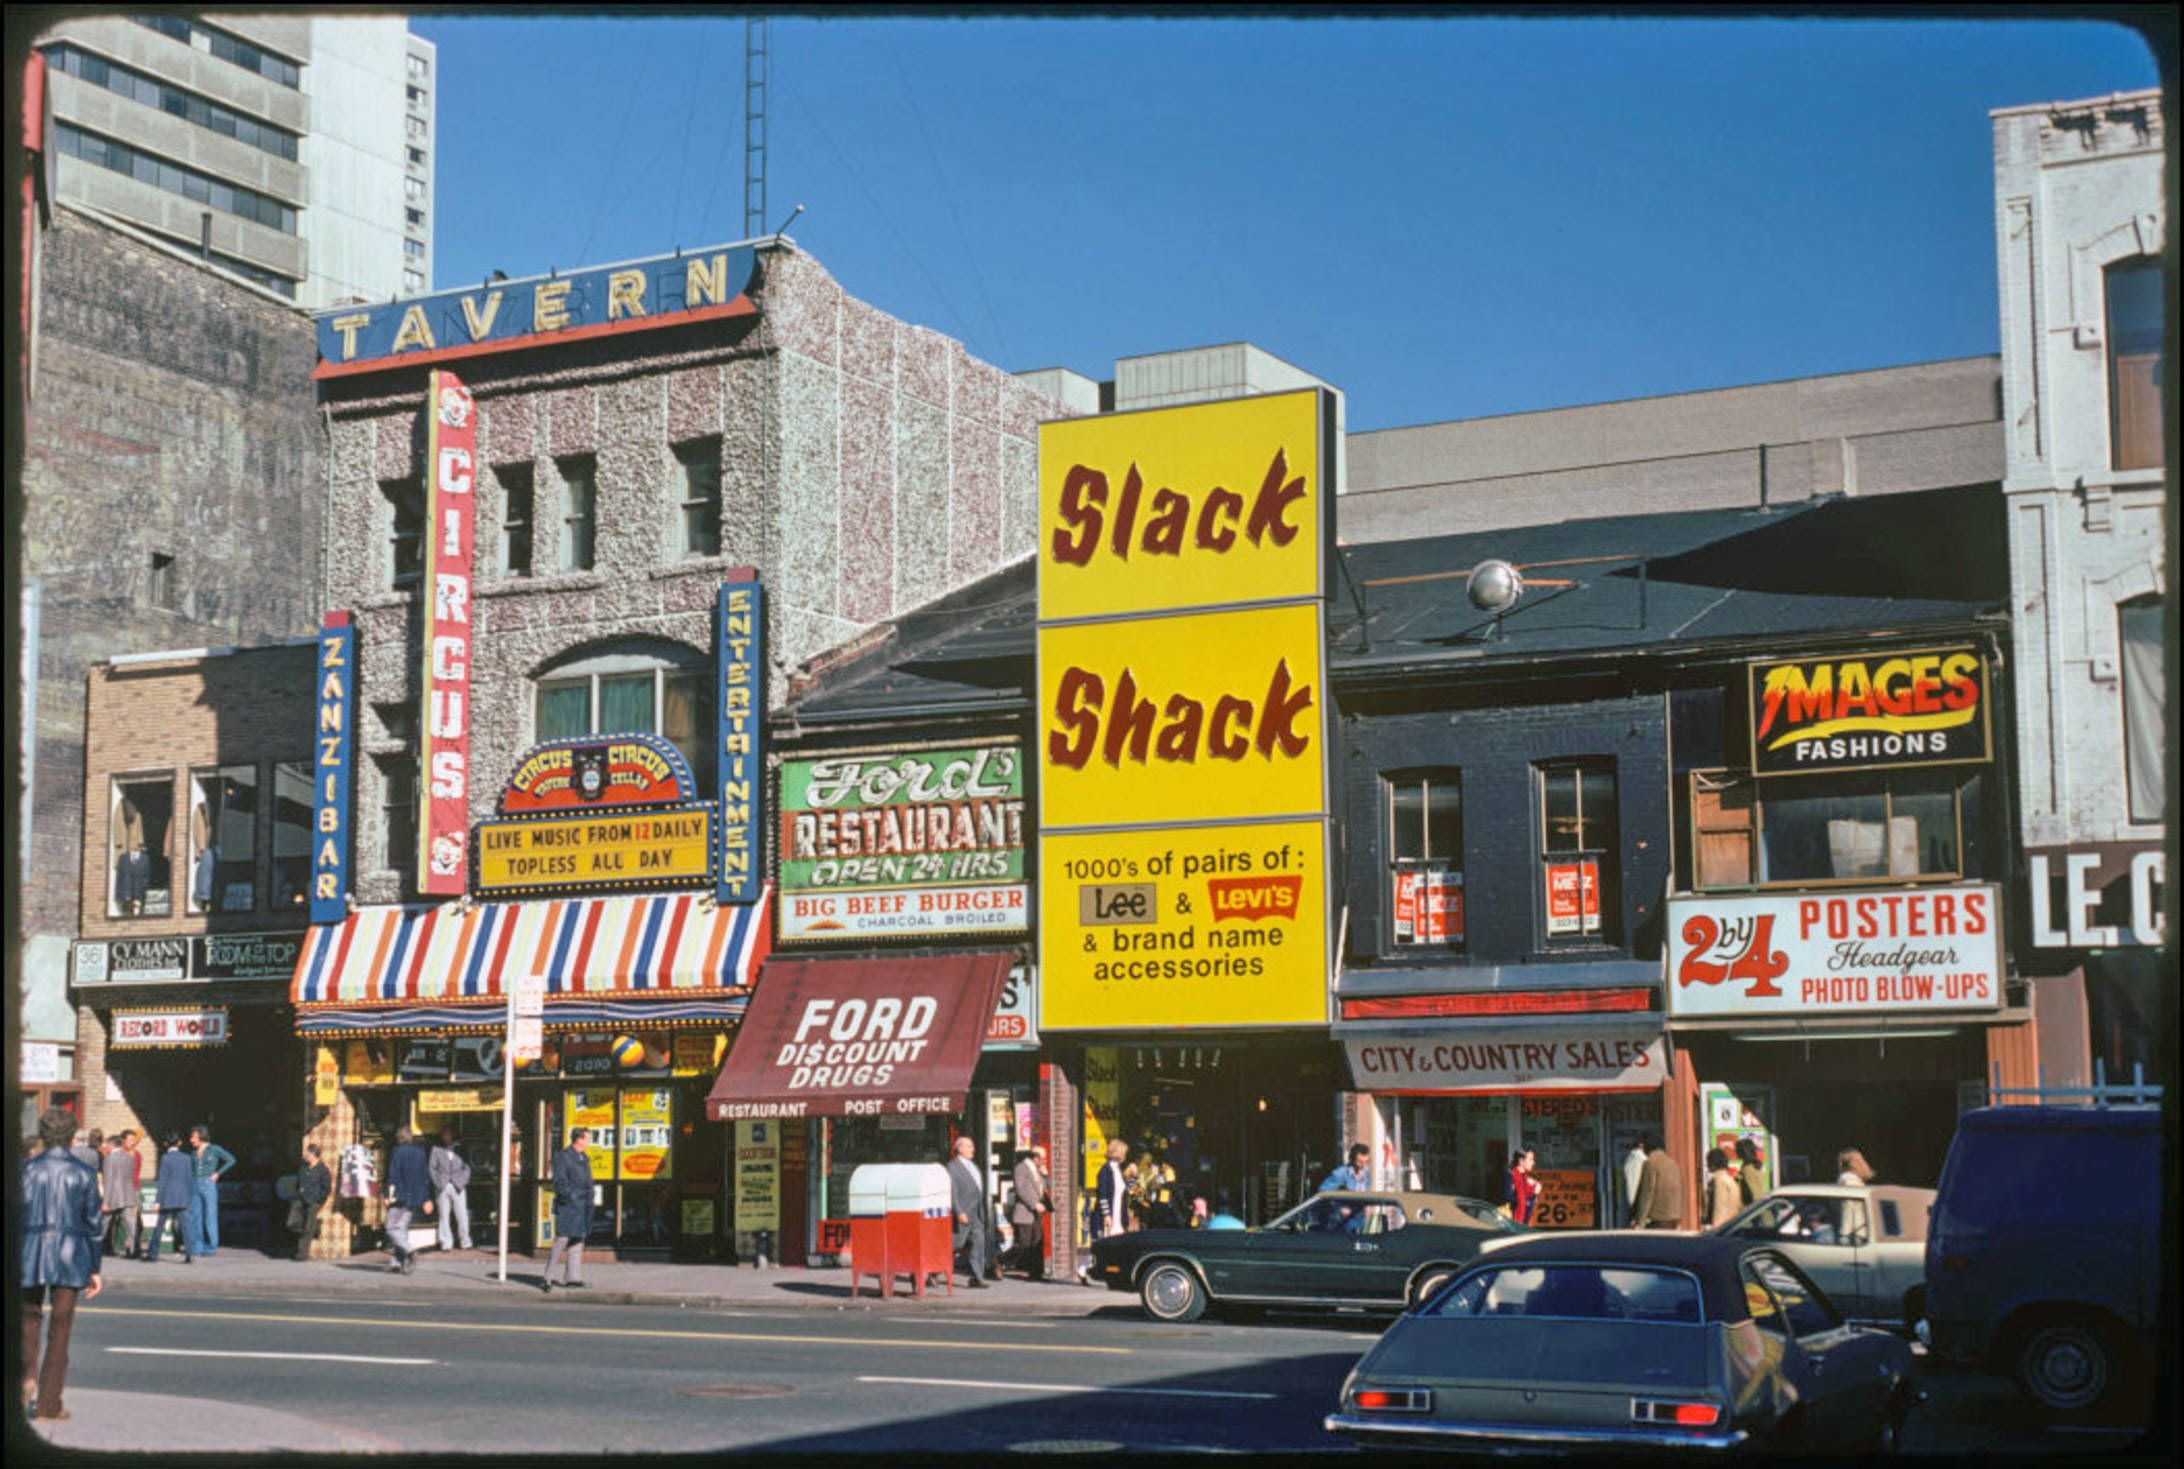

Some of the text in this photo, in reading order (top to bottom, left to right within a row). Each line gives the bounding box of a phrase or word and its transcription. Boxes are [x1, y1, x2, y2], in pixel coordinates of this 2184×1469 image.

[332, 254, 726, 361] TAVERN
[1052, 446, 1306, 567] Slack
[429, 447, 472, 800] CIRCUS
[1758, 653, 1979, 741] IMAGES
[1048, 656, 1314, 771] Shack
[724, 590, 751, 896] ENTERTAINMENT
[1796, 732, 1948, 761] FASHIONS
[316, 637, 345, 900] ZANZIBAR
[514, 749, 573, 792] CIRCUS
[608, 745, 671, 782] CIRCUS
[806, 747, 1017, 808] Ford's
[486, 819, 702, 850] LIVE MUSIC FROM 12 DAILY
[795, 801, 1025, 858] RESTAURANT
[507, 850, 672, 876] TOPLESS ALL DAY
[811, 858, 906, 886] OPEN
[950, 851, 1011, 878] HRS
[1064, 858, 1138, 879] 1000's
[1147, 851, 1173, 875] of
[1183, 849, 1252, 878] pairs
[794, 890, 1023, 917] BIG BEEF BURGER
[1095, 889, 1147, 918] Lee
[1176, 893, 1192, 914] &
[1800, 893, 1986, 940] POSTERS
[857, 912, 1006, 929] CHARCOAL BROILED
[135, 940, 184, 958] MANN
[267, 943, 296, 962] TOP
[1083, 926, 1283, 951] & brand name
[1094, 953, 1263, 980] accessories
[1827, 940, 1960, 976] Headgear
[1801, 972, 1989, 1003] PHOTO BLOW-UPS
[121, 1018, 220, 1037] RECORD WORLD
[794, 997, 937, 1042] FORD
[1361, 1041, 1650, 1072] CITY & COUNTRY SALES
[789, 1065, 894, 1089] DRUGS
[719, 1097, 950, 1118] RESTAURANT POST OFFICE
